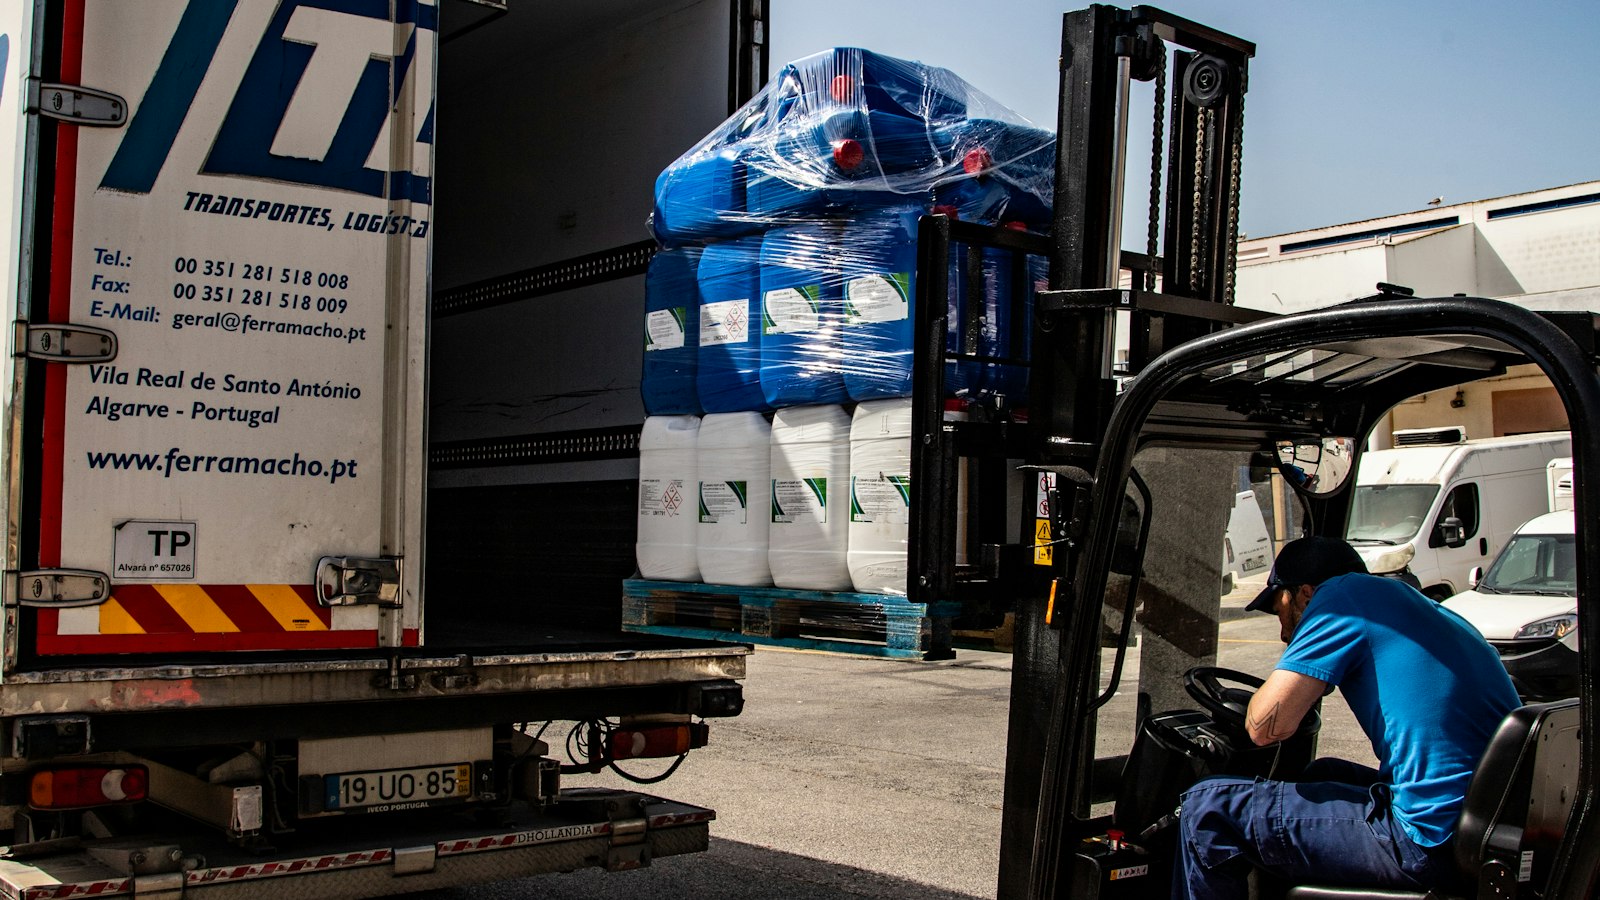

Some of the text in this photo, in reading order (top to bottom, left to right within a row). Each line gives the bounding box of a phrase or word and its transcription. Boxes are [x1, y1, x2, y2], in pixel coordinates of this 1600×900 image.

[184, 191, 429, 238] TRANSPORTES, LOGÍSTA
[94, 248, 131, 267] Tel.:
[92, 275, 129, 293] Fax:
[175, 257, 349, 290] 00 351 281 518 008
[174, 283, 348, 314] 00 351 281 518 009
[91, 301, 366, 344] E-Mail: geral@ferramacho.pt
[89, 365, 360, 399] Vila Real de Santo António
[86, 396, 168, 421] Algarve
[192, 402, 279, 428] Portugal
[87, 448, 358, 483] www.ferramacho.pt
[148, 531, 190, 556] TP
[118, 563, 147, 572] Alvará
[160, 564, 191, 572] 657026
[367, 802, 430, 813] IVECO PORTUGAL
[517, 825, 593, 843] DHOLLANDIA
